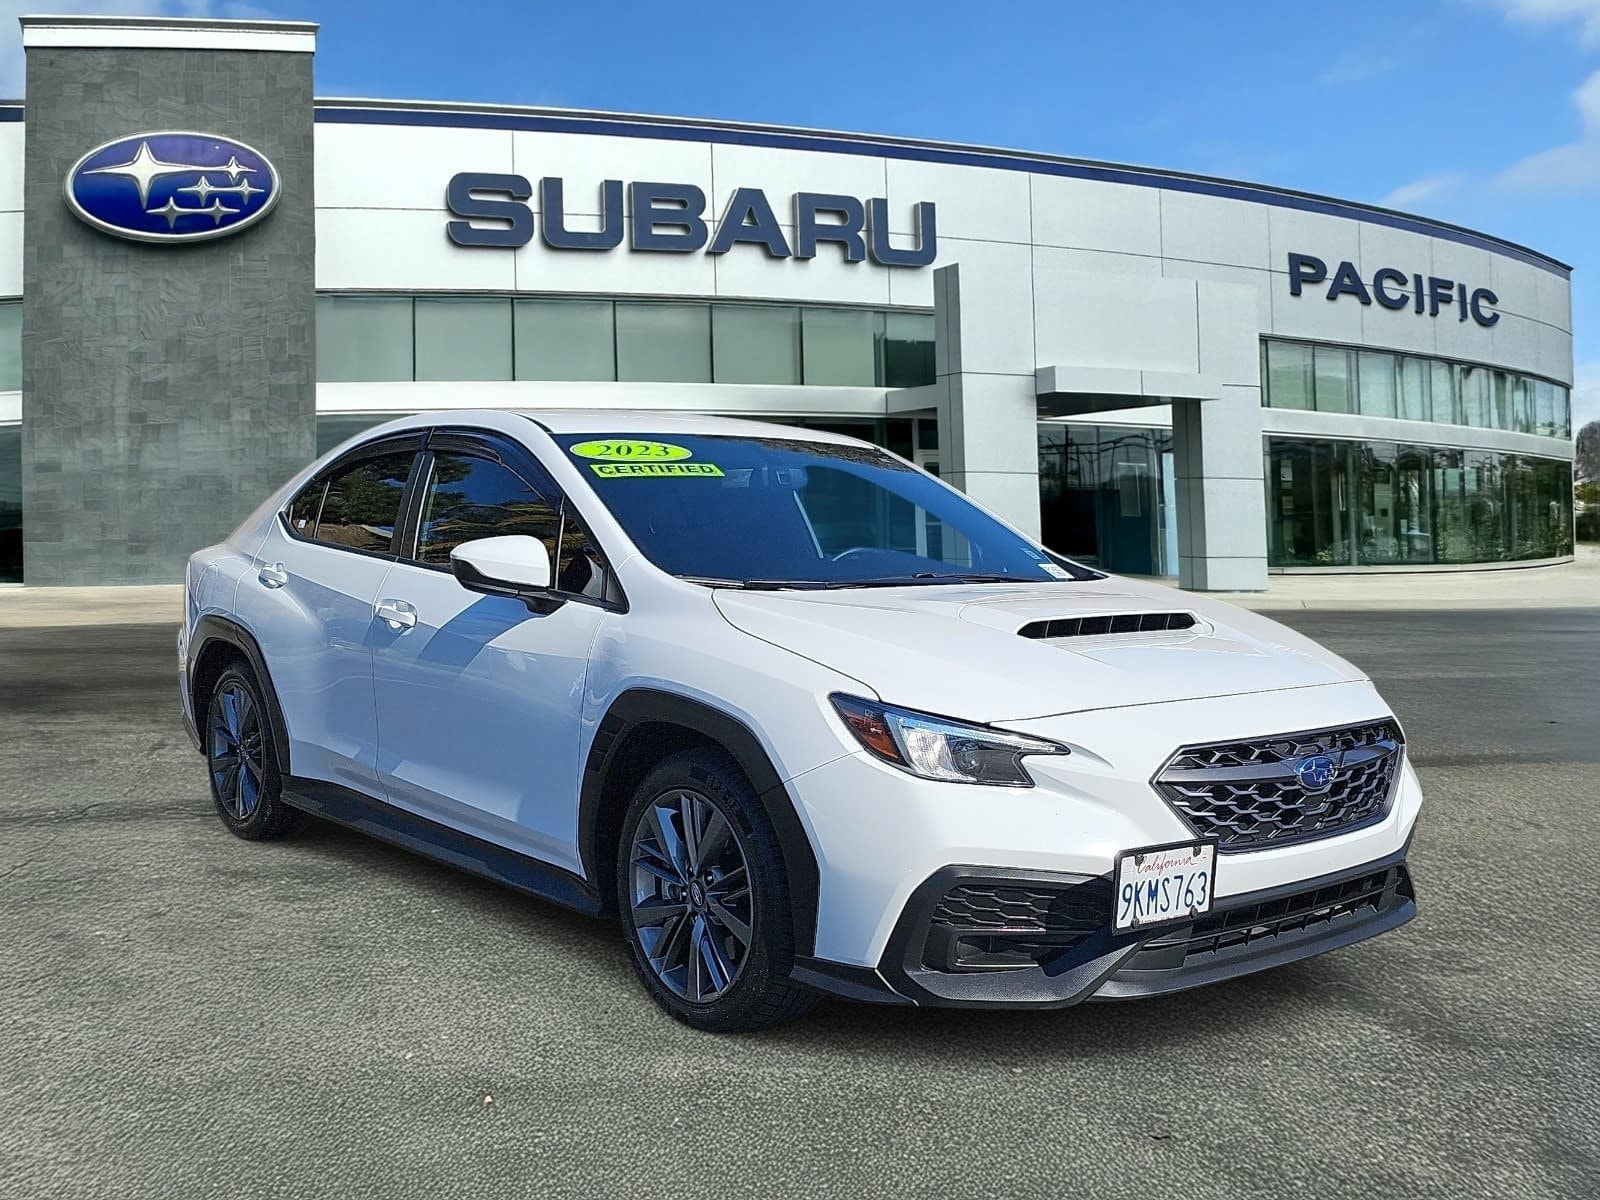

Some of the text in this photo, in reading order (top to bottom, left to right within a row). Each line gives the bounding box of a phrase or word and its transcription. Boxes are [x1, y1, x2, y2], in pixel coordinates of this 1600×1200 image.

[447, 171, 937, 267] SUBARU
[1288, 252, 1500, 327] PACIFIC
[596, 444, 670, 457] 2023
[599, 464, 714, 475] CERTIFIED
[1137, 852, 1198, 875] California
[1120, 871, 1208, 921] 9KMS763
